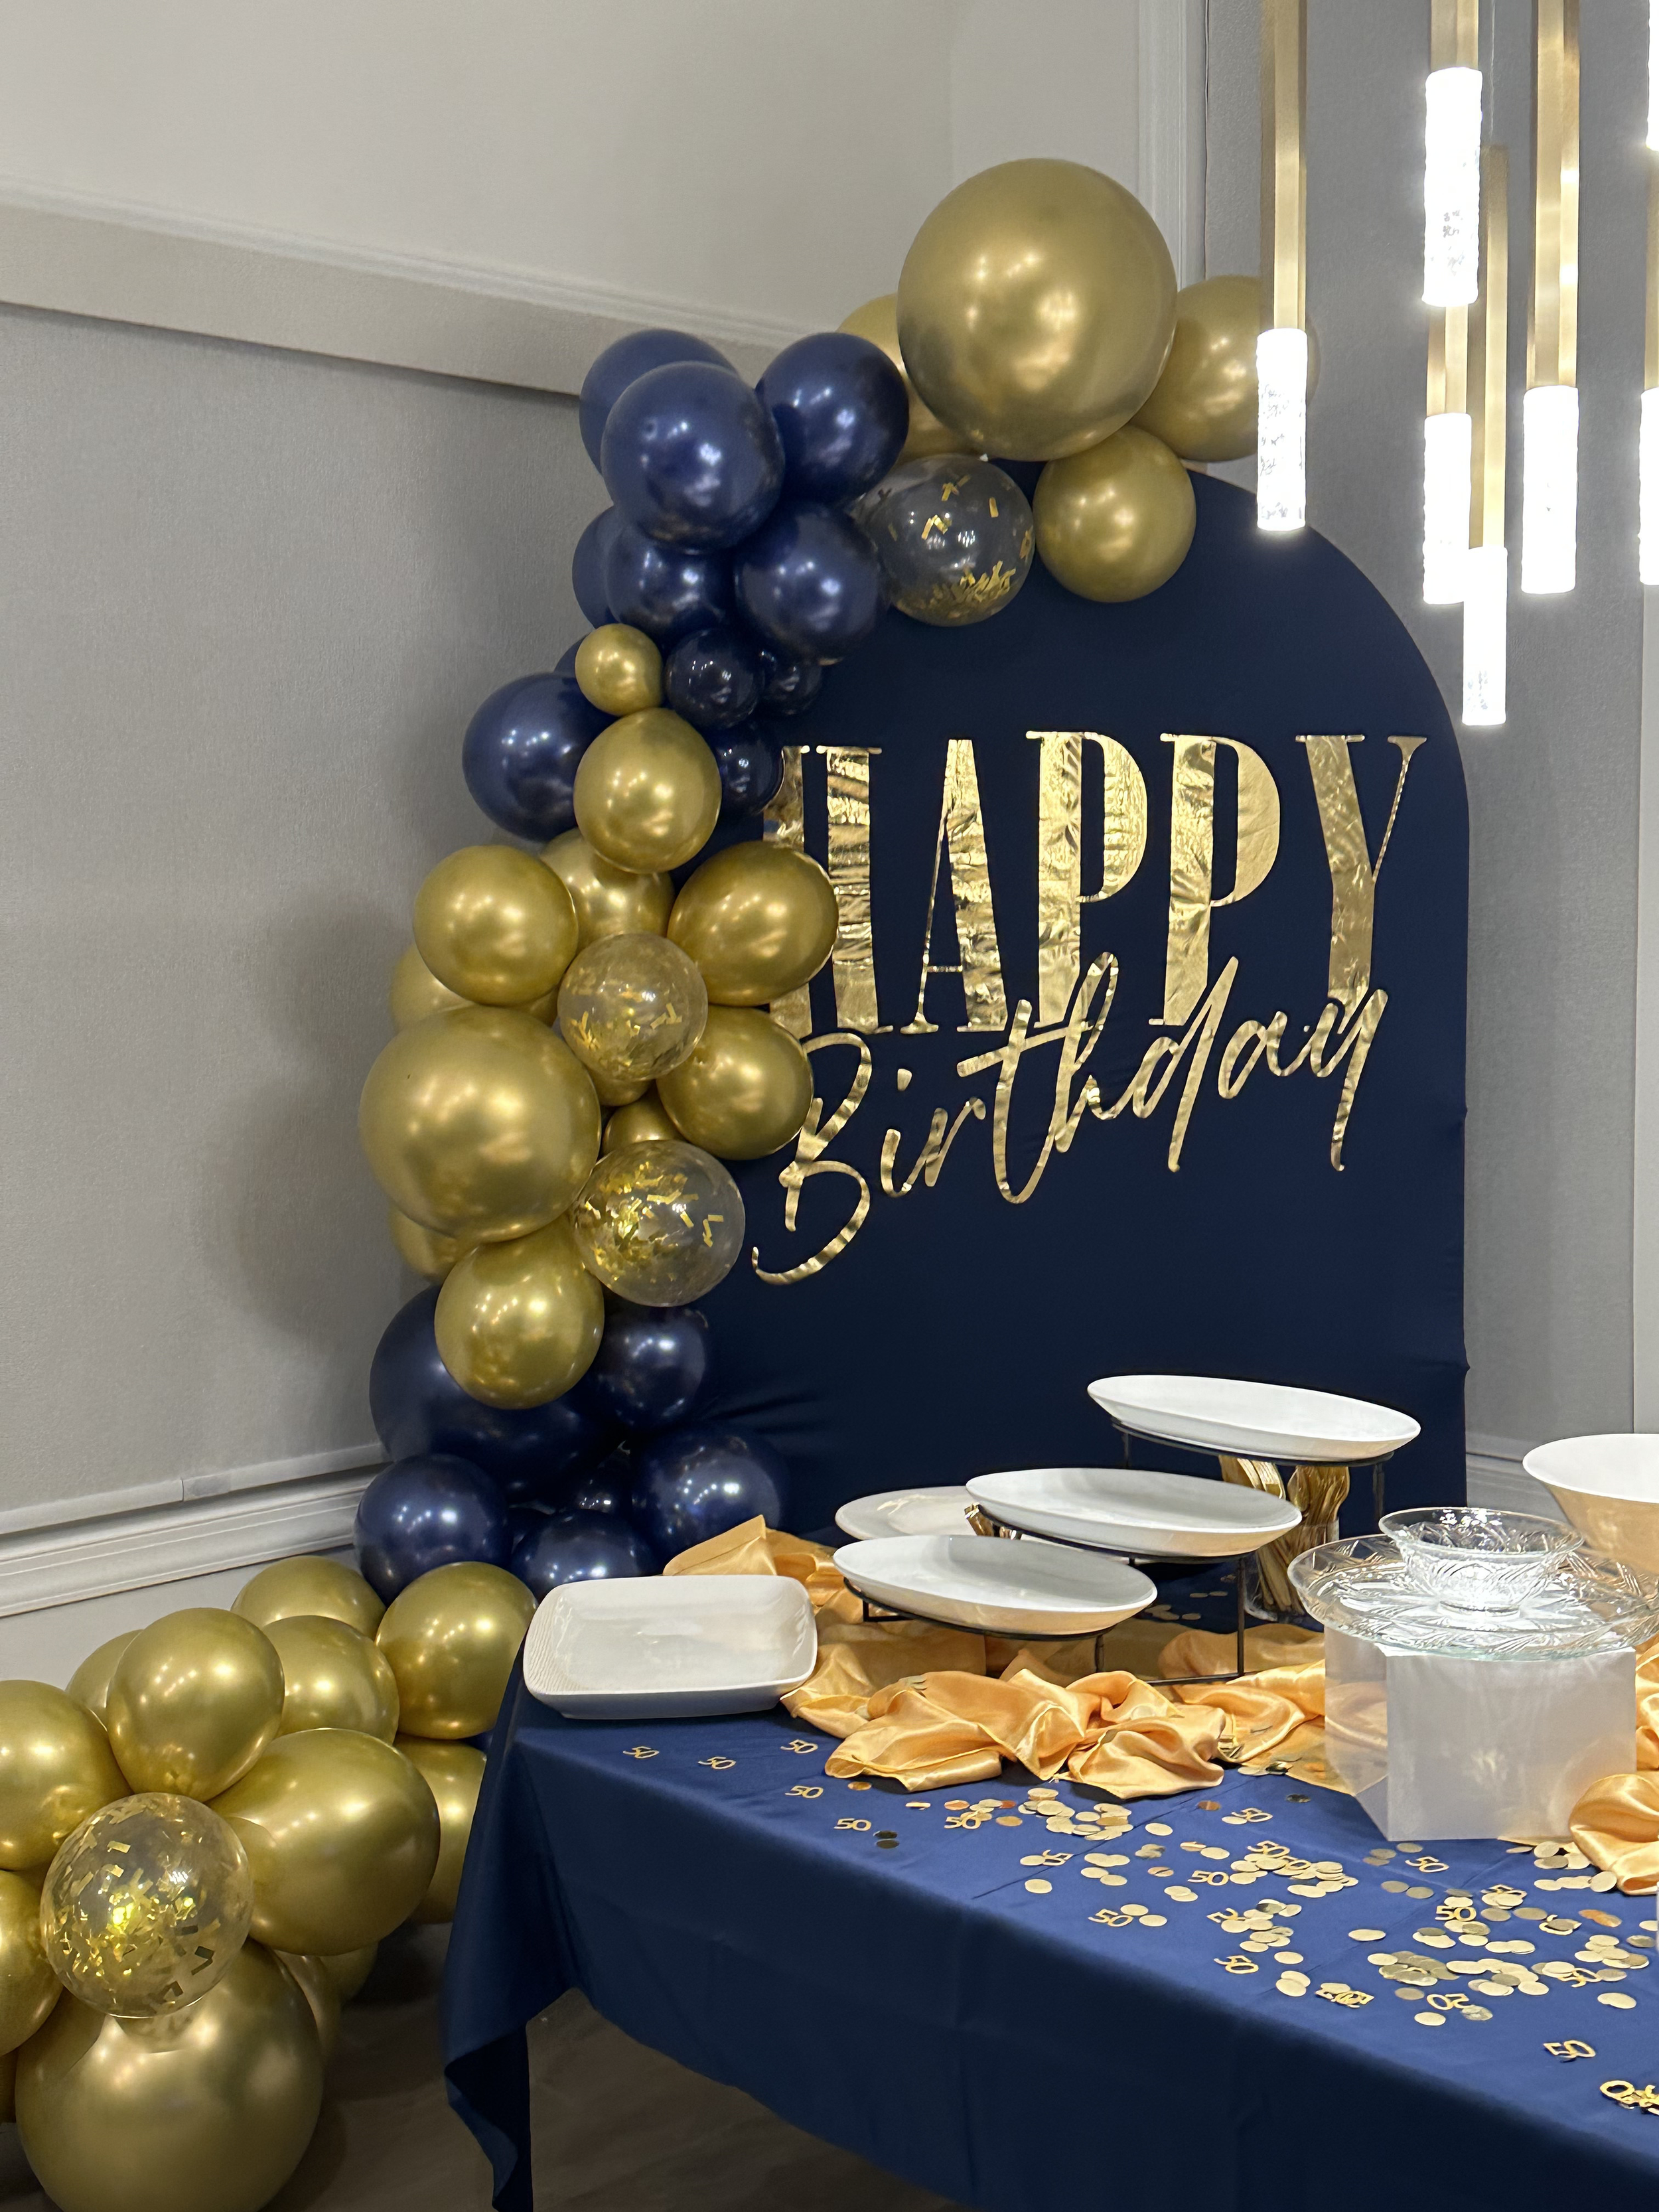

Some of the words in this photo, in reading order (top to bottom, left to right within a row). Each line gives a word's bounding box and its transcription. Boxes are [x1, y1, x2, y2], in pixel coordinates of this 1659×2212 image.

[763, 730, 1427, 1034] HAPPY
[751, 952, 1388, 1284] Birthday
[780, 1738, 819, 1753] 50
[697, 1756, 737, 1770] 50
[784, 1785, 824, 1799] 50
[944, 1816, 981, 1830] 50
[1231, 1807, 1273, 1823] 50
[833, 1818, 871, 1832] 50
[1247, 1840, 1291, 1858] 50
[1405, 1856, 1450, 1873] 50
[1187, 1870, 1230, 1886] 50
[1088, 1908, 1134, 1927] 50
[1435, 1905, 1477, 1922] 50
[1214, 1954, 1260, 1974] 50
[1543, 2039, 1596, 2059] 50
